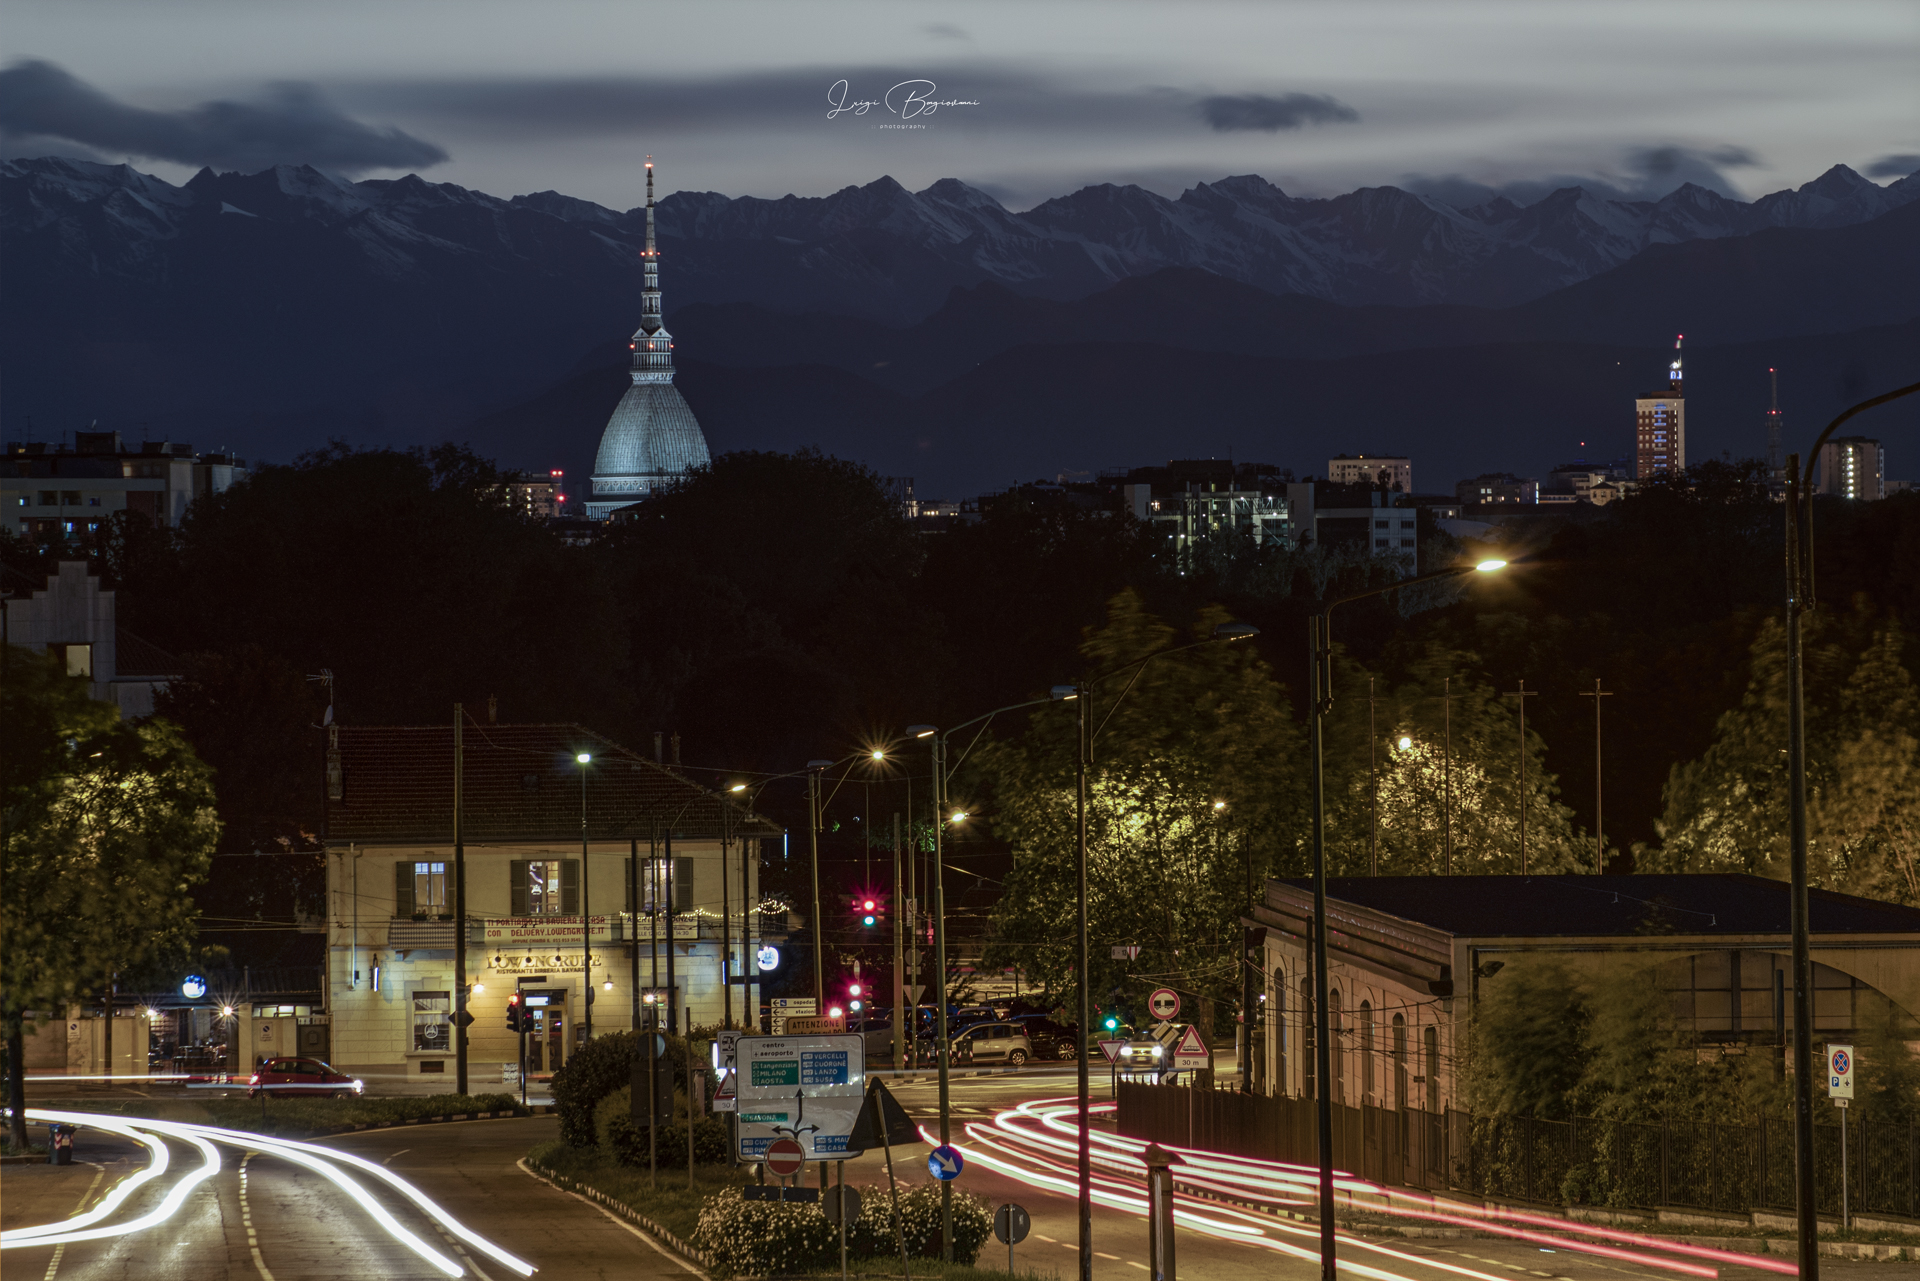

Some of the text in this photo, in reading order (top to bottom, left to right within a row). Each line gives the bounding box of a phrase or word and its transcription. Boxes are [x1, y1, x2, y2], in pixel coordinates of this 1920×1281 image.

[487, 929, 502, 938] CON
[792, 1020, 840, 1029] ATTENZIONE
[760, 1050, 794, 1058] aeroporto
